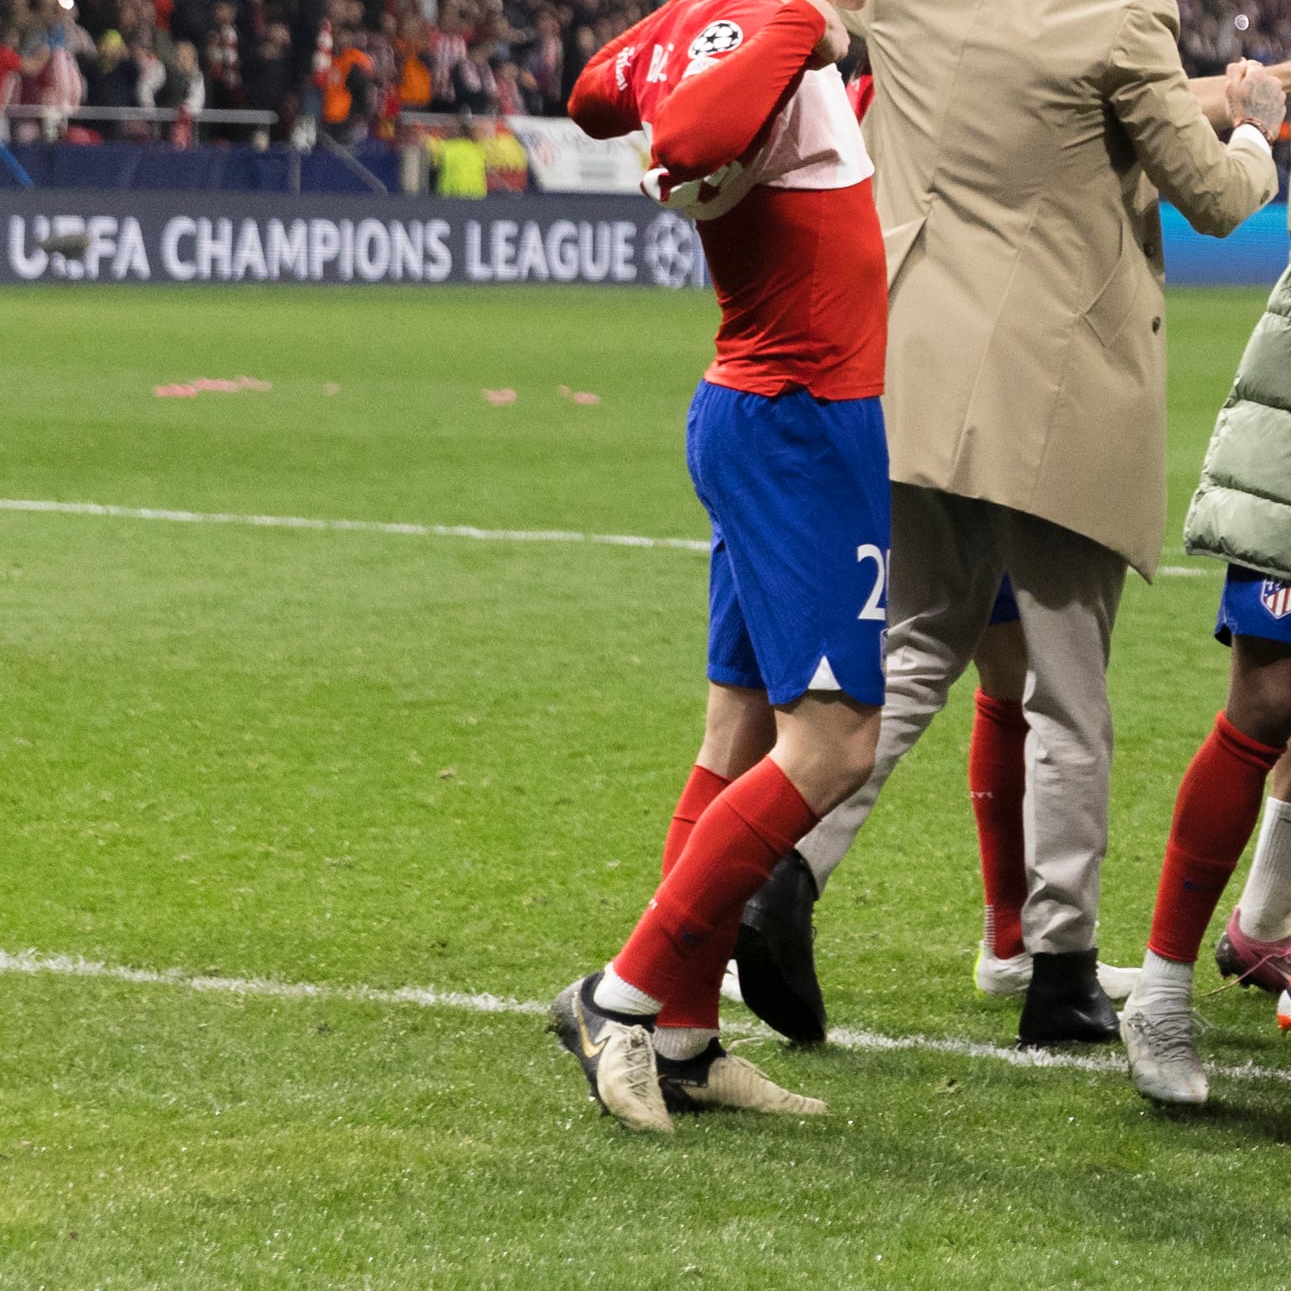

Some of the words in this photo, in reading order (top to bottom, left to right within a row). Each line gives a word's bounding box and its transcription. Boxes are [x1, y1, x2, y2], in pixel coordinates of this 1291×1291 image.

[8, 214, 151, 281] UEFA
[160, 215, 452, 282] CHAMPIONS
[464, 219, 637, 282] LEAGUE
[857, 543, 891, 621] 2
